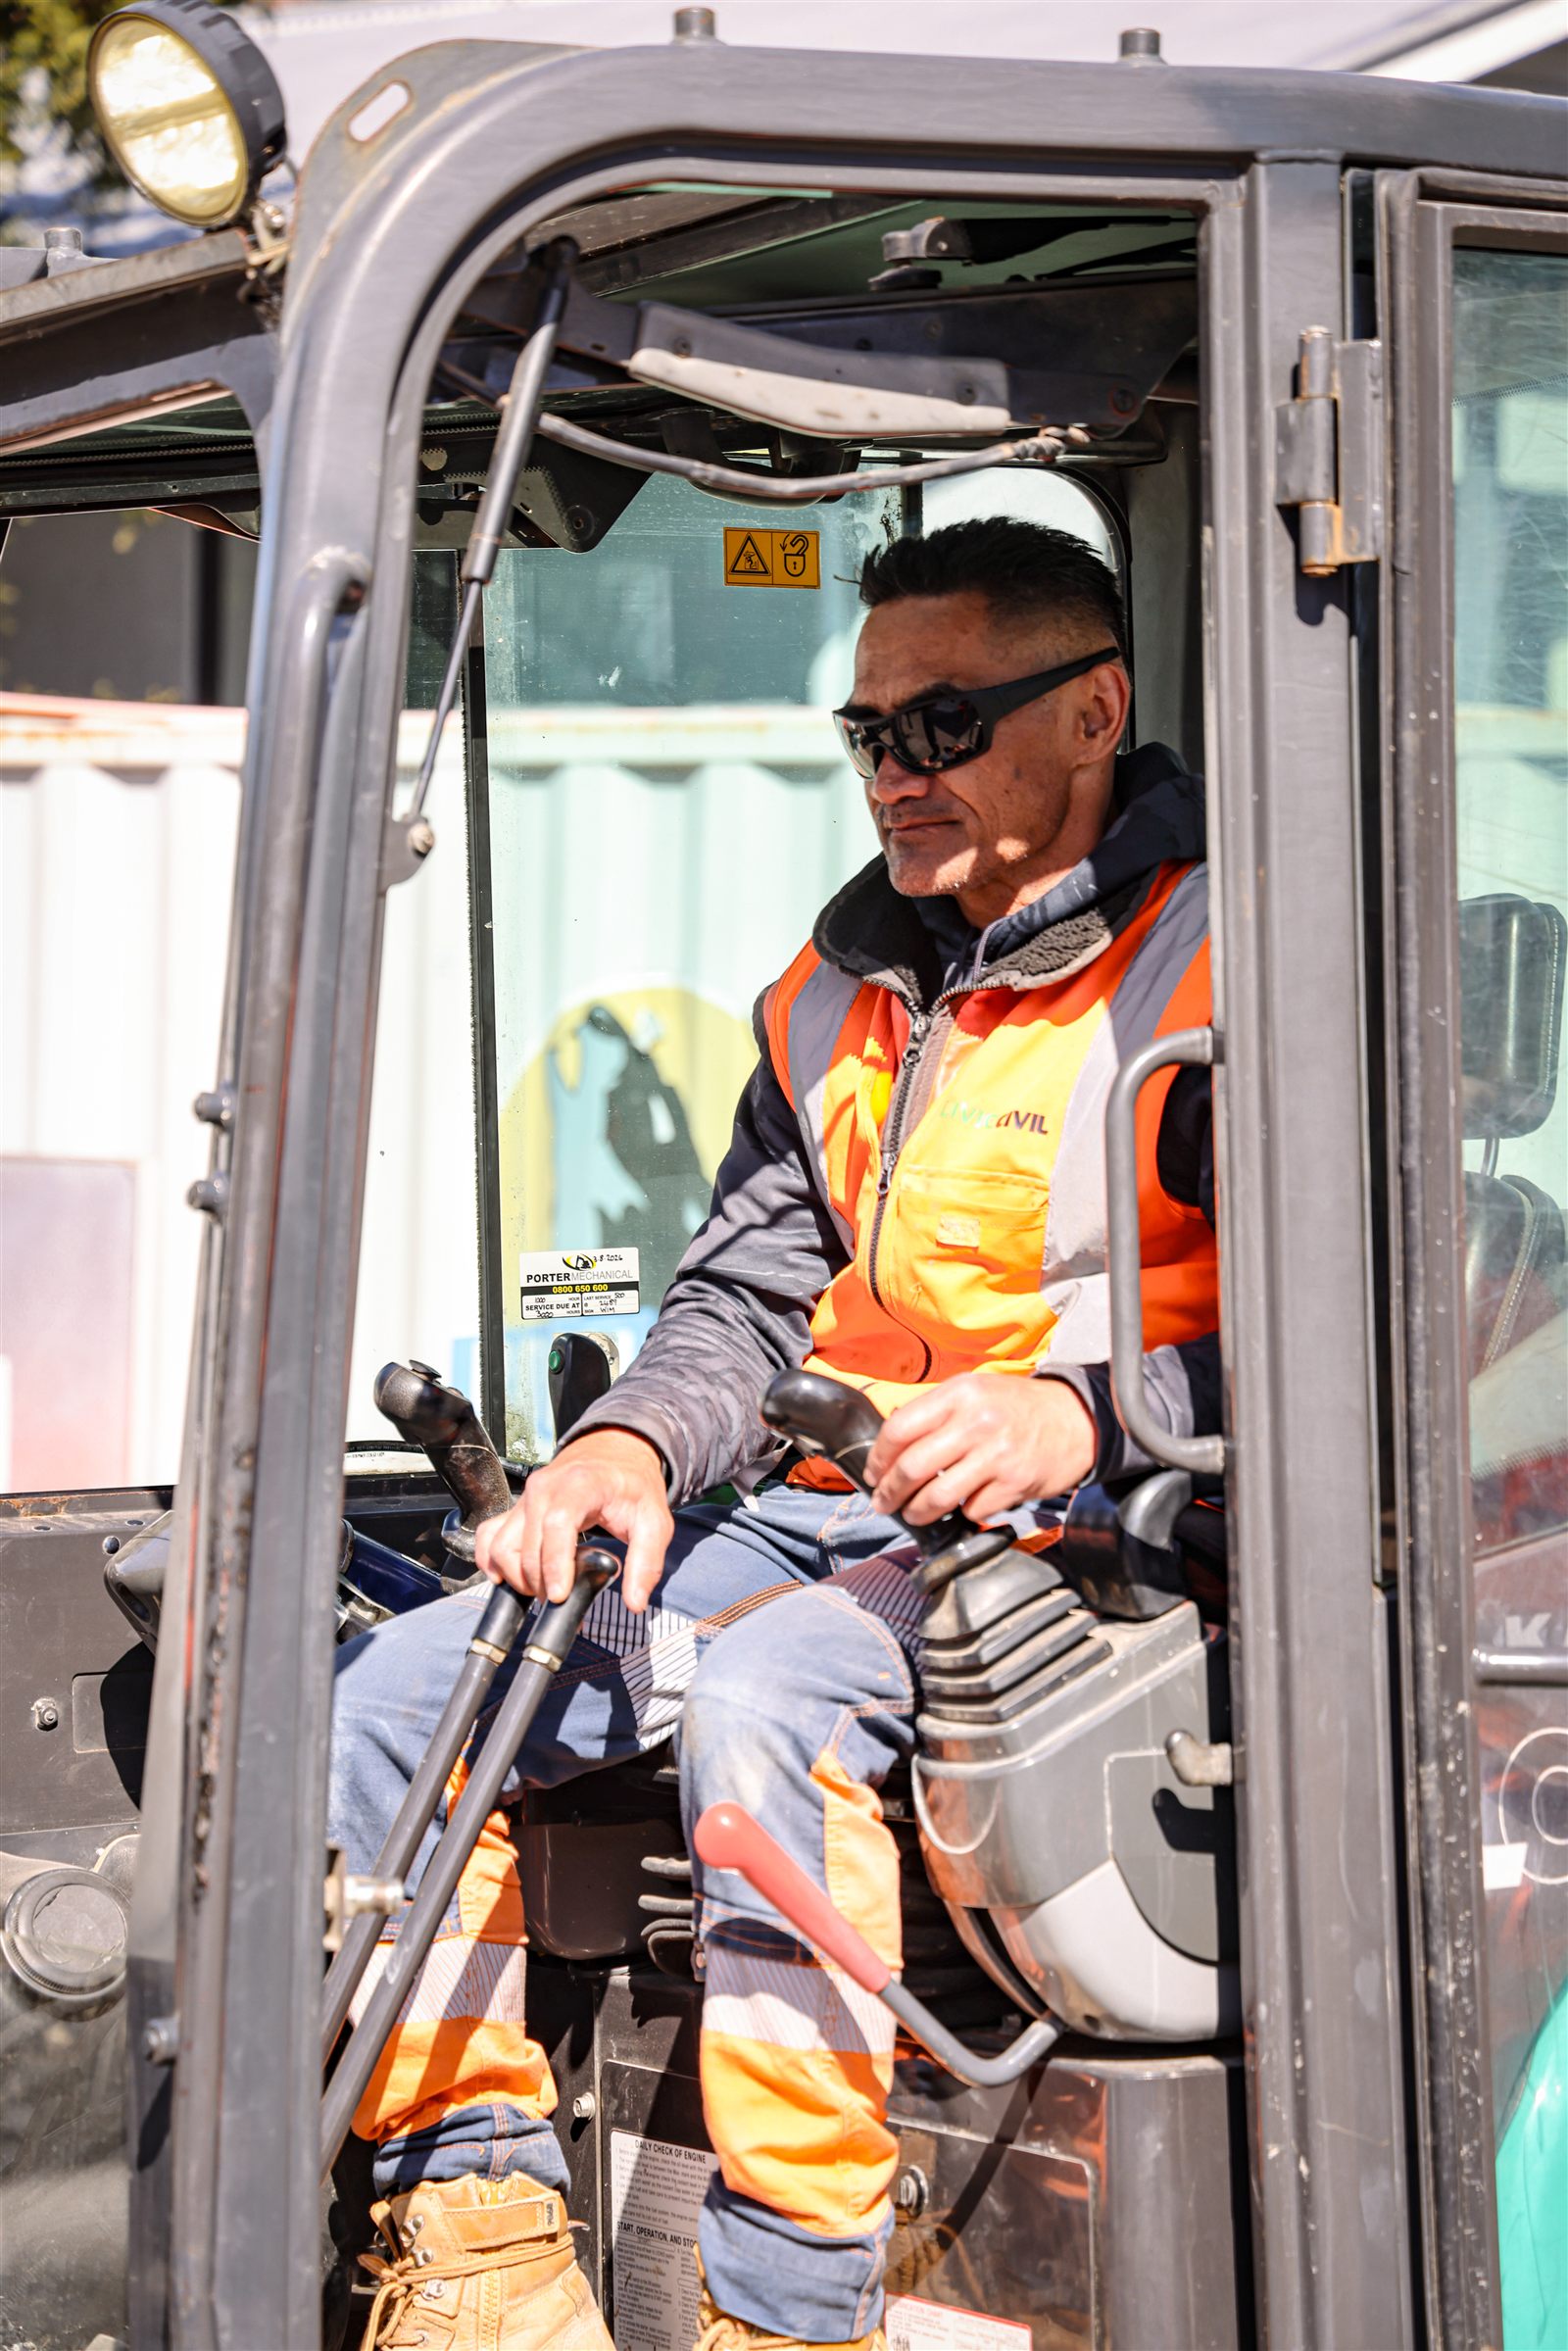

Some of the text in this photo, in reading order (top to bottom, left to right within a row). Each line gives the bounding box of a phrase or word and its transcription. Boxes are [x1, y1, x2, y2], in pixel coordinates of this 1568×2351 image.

[635, 2140, 706, 2164] DAILY CHECK OF ENGINE
[670, 2234, 682, 2245] AND
